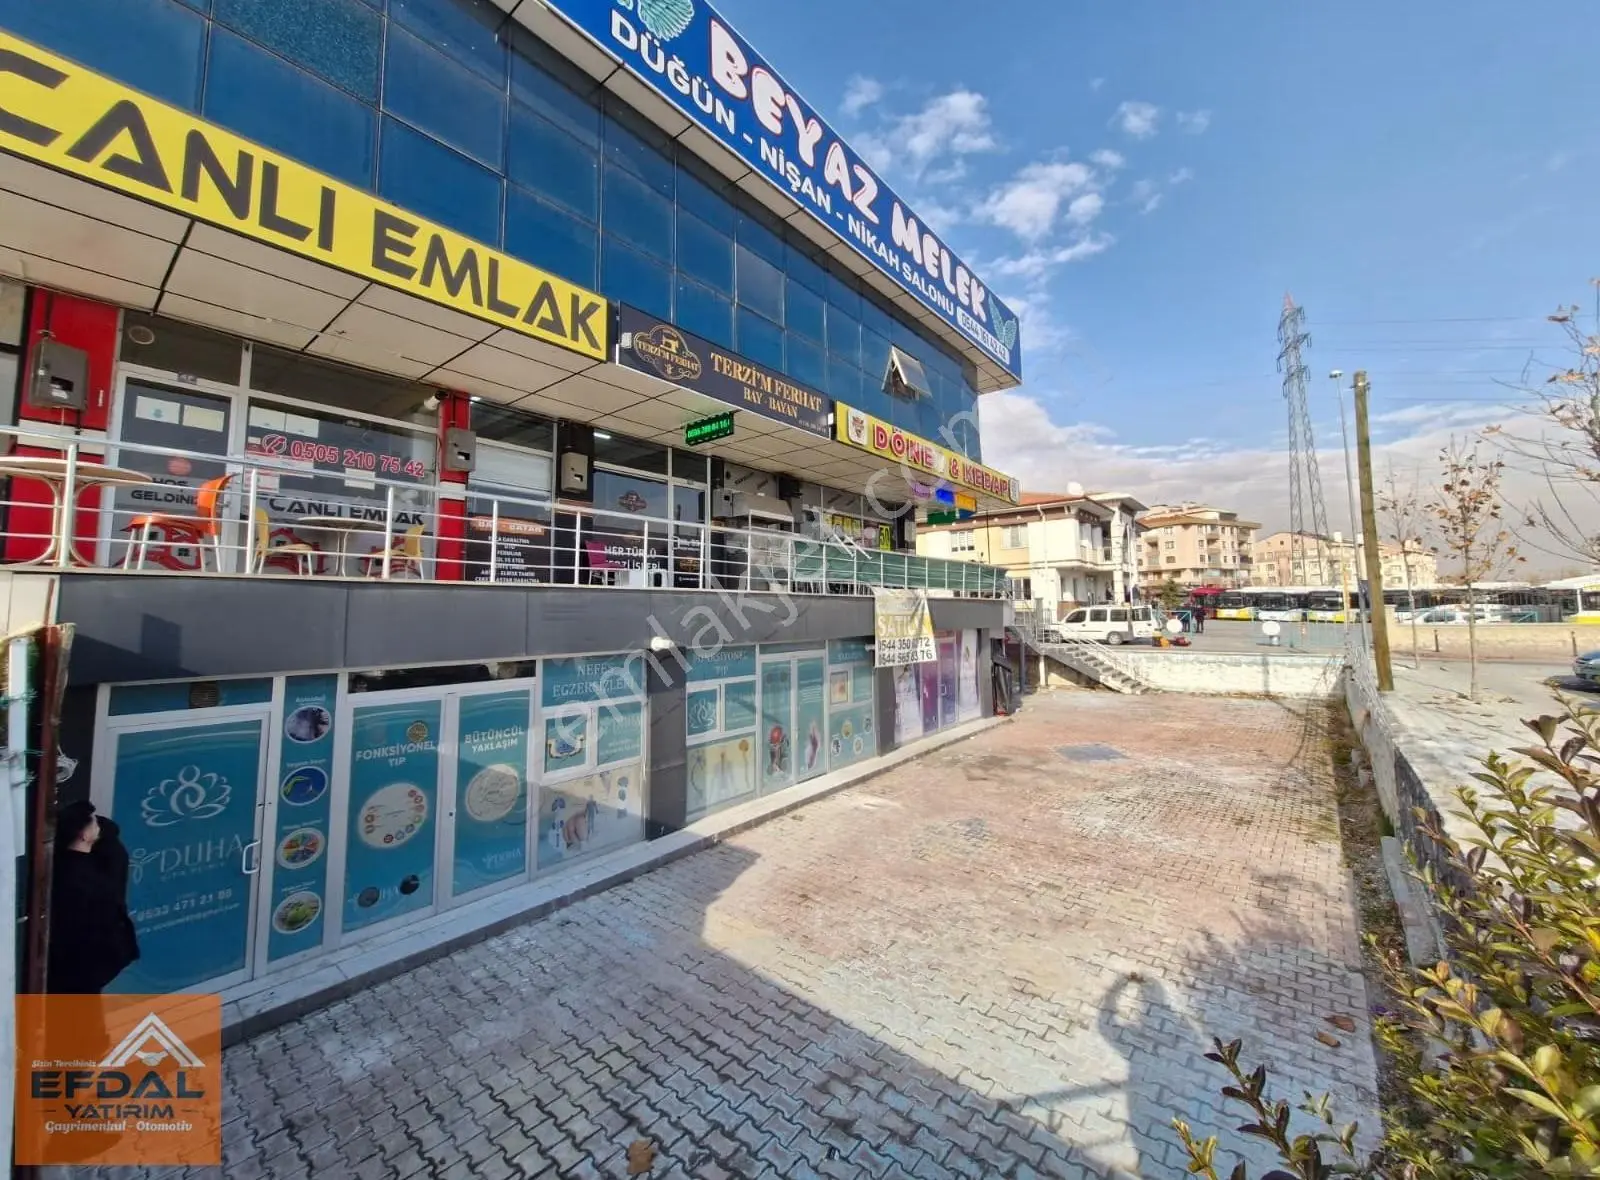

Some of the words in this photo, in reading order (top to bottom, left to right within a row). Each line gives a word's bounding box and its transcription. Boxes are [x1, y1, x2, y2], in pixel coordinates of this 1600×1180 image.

[611, 9, 736, 135] DÜĞÜN
[760, 137, 832, 214] NİŞAN
[848, 213, 900, 273] NİKAH
[901, 261, 954, 316] SALONU
[710, 18, 879, 225] BEYAZ
[891, 202, 988, 322] MELEK
[0, 48, 337, 252] CANLI
[371, 207, 602, 351] EMLAK
[743, 386, 764, 405] BAY
[769, 398, 799, 419] BAYAN
[774, 380, 822, 412] FERHAT
[290, 440, 339, 464] 0505
[343, 448, 376, 470] 210
[380, 455, 401, 474] 75
[404, 460, 425, 478] 42
[950, 457, 960, 479] &
[962, 462, 1009, 496] KEBAP
[604, 544, 625, 556] HER
[626, 546, 657, 559] TÜRÜ
[577, 663, 611, 677] NEFE
[355, 739, 437, 762] FONKSİYONEL
[464, 724, 526, 746] BÜTÜNCÜL
[471, 737, 519, 756] YAKLAŞIM
[387, 756, 408, 768] TIP
[160, 833, 243, 873] DUHA
